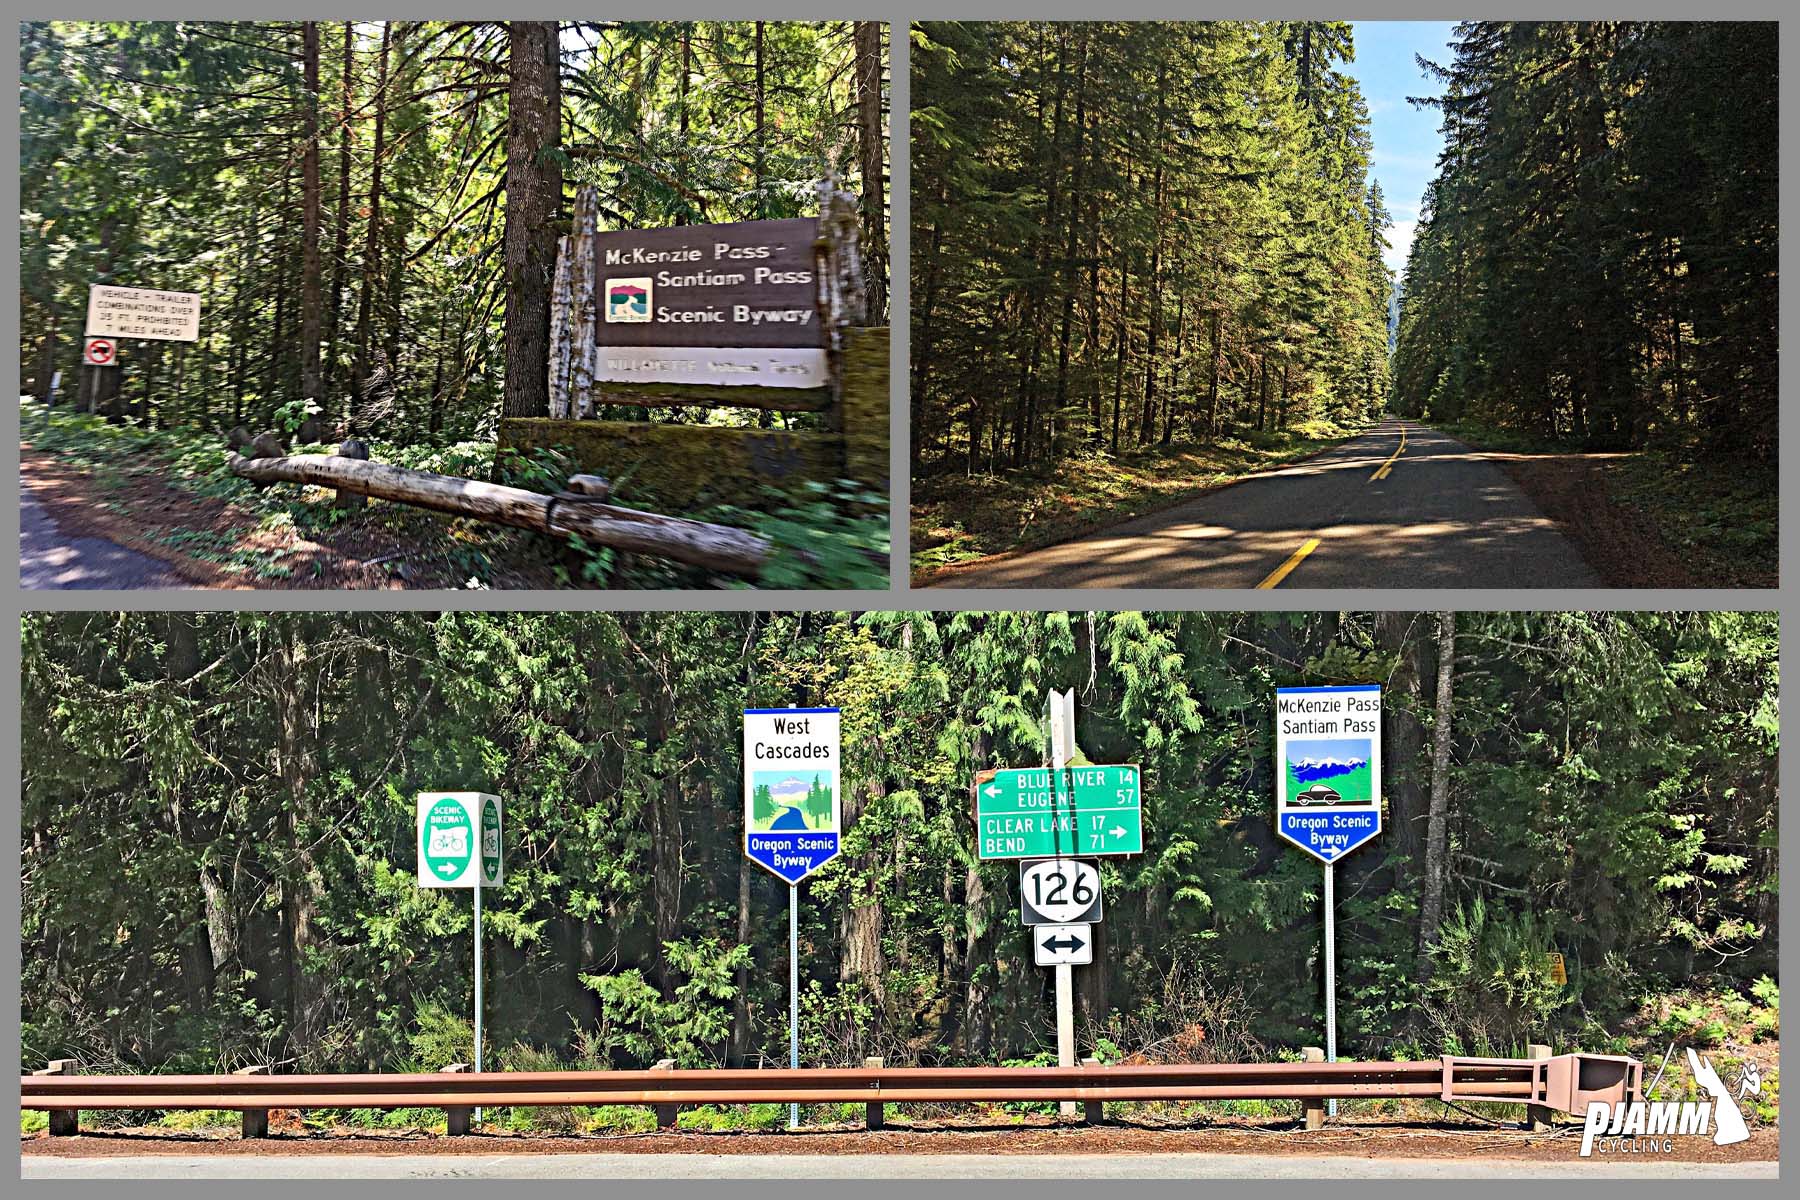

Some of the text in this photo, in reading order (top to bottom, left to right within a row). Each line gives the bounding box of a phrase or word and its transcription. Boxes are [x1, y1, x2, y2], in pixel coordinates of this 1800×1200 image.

[605, 246, 702, 265] McKenzie
[714, 243, 770, 260] Pass
[656, 267, 813, 287] Santiam Pass
[102, 290, 140, 300] VEHICLE
[97, 301, 166, 313] COMBINATIONS
[656, 304, 814, 326] Scenic Byway
[119, 325, 145, 334] MILES
[1278, 697, 1380, 714] McKenzie Pass
[773, 717, 810, 735] West
[1282, 718, 1376, 735] Santiam Pass
[755, 741, 830, 760] Cascades
[1017, 770, 1134, 789] BLUE RIVER 14
[1018, 789, 1134, 808] EUGENE 57
[430, 815, 465, 824] BIKEWAY
[434, 806, 462, 815] SCENIC
[986, 815, 1106, 835] CLEAR LAKE 17
[1287, 814, 1372, 832] Oregon Scenic
[751, 836, 835, 854] Oregon Scenic
[986, 834, 1105, 853] BEND 71
[1310, 832, 1349, 848] Byway
[773, 853, 813, 872] Byway
[1031, 872, 1094, 906] 126
